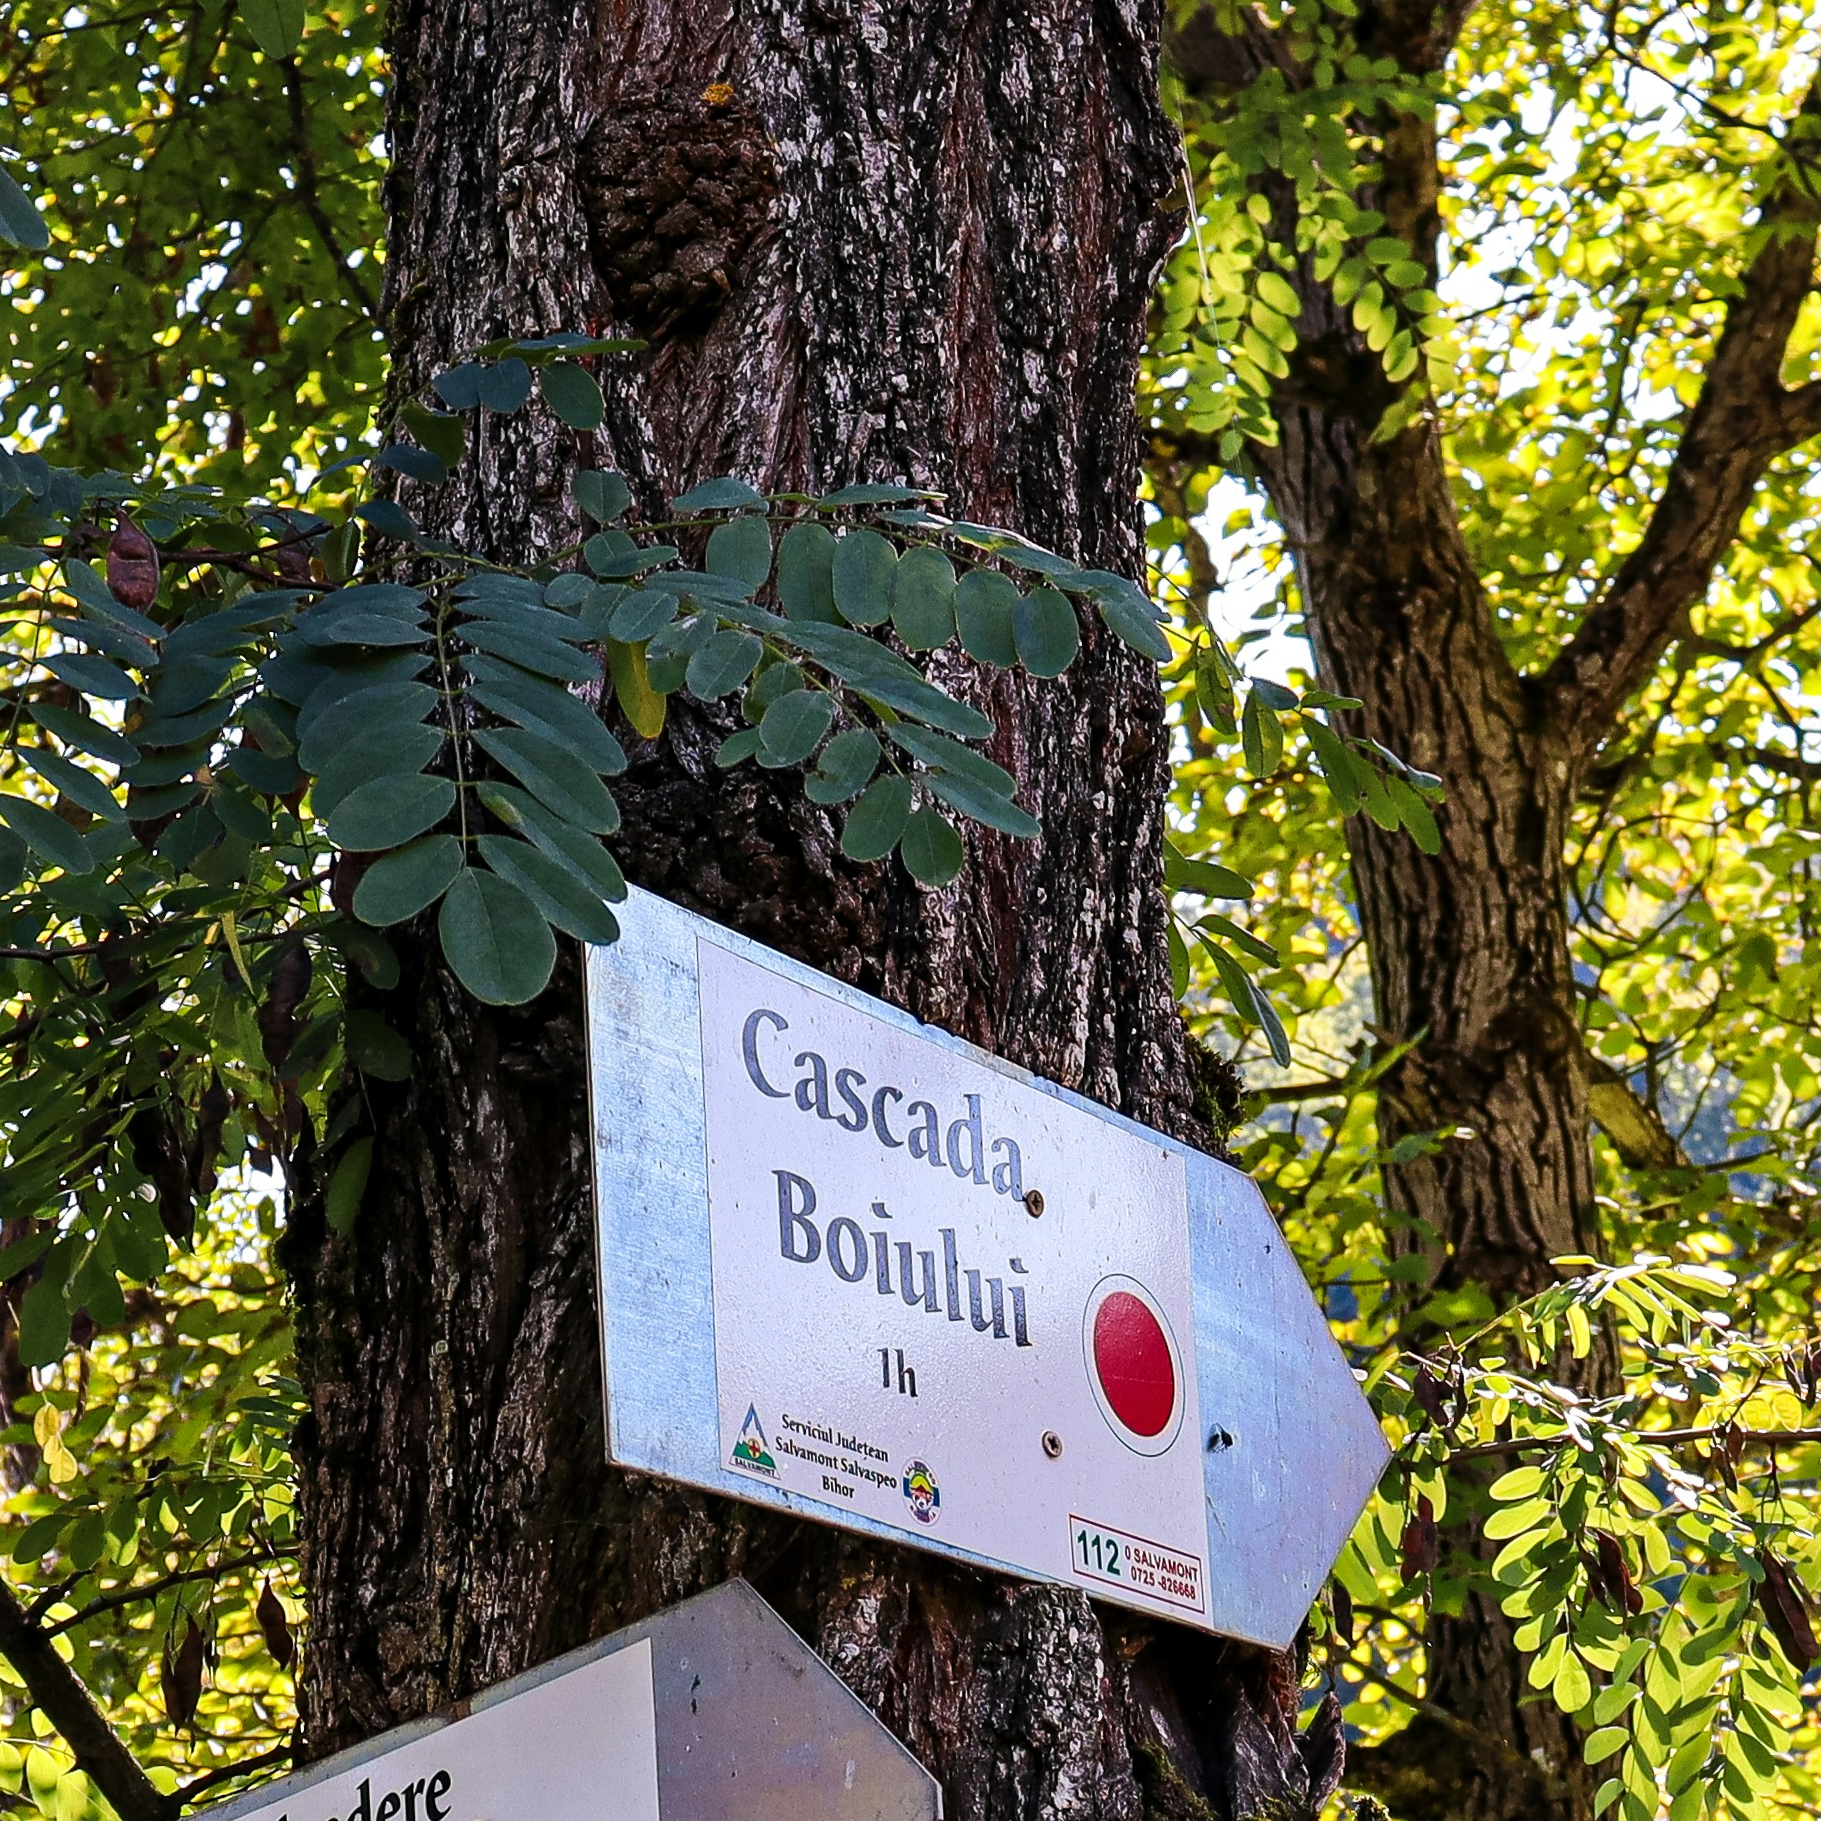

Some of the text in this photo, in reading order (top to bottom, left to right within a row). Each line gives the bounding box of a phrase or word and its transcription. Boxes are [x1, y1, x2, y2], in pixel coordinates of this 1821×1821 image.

[742, 1008, 1027, 1201] Cascada
[771, 1169, 1032, 1347] Boiului
[877, 1348, 918, 1397] 1h
[781, 1414, 833, 1445] Serviciul
[775, 1436, 838, 1469] Salvamont
[841, 1458, 897, 1489] Salvaspeo
[822, 1475, 855, 1498] Bihor
[1078, 1530, 1121, 1576] 112
[1133, 1548, 1198, 1582] SALVAMONT
[1131, 1566, 1155, 1587] 0725
